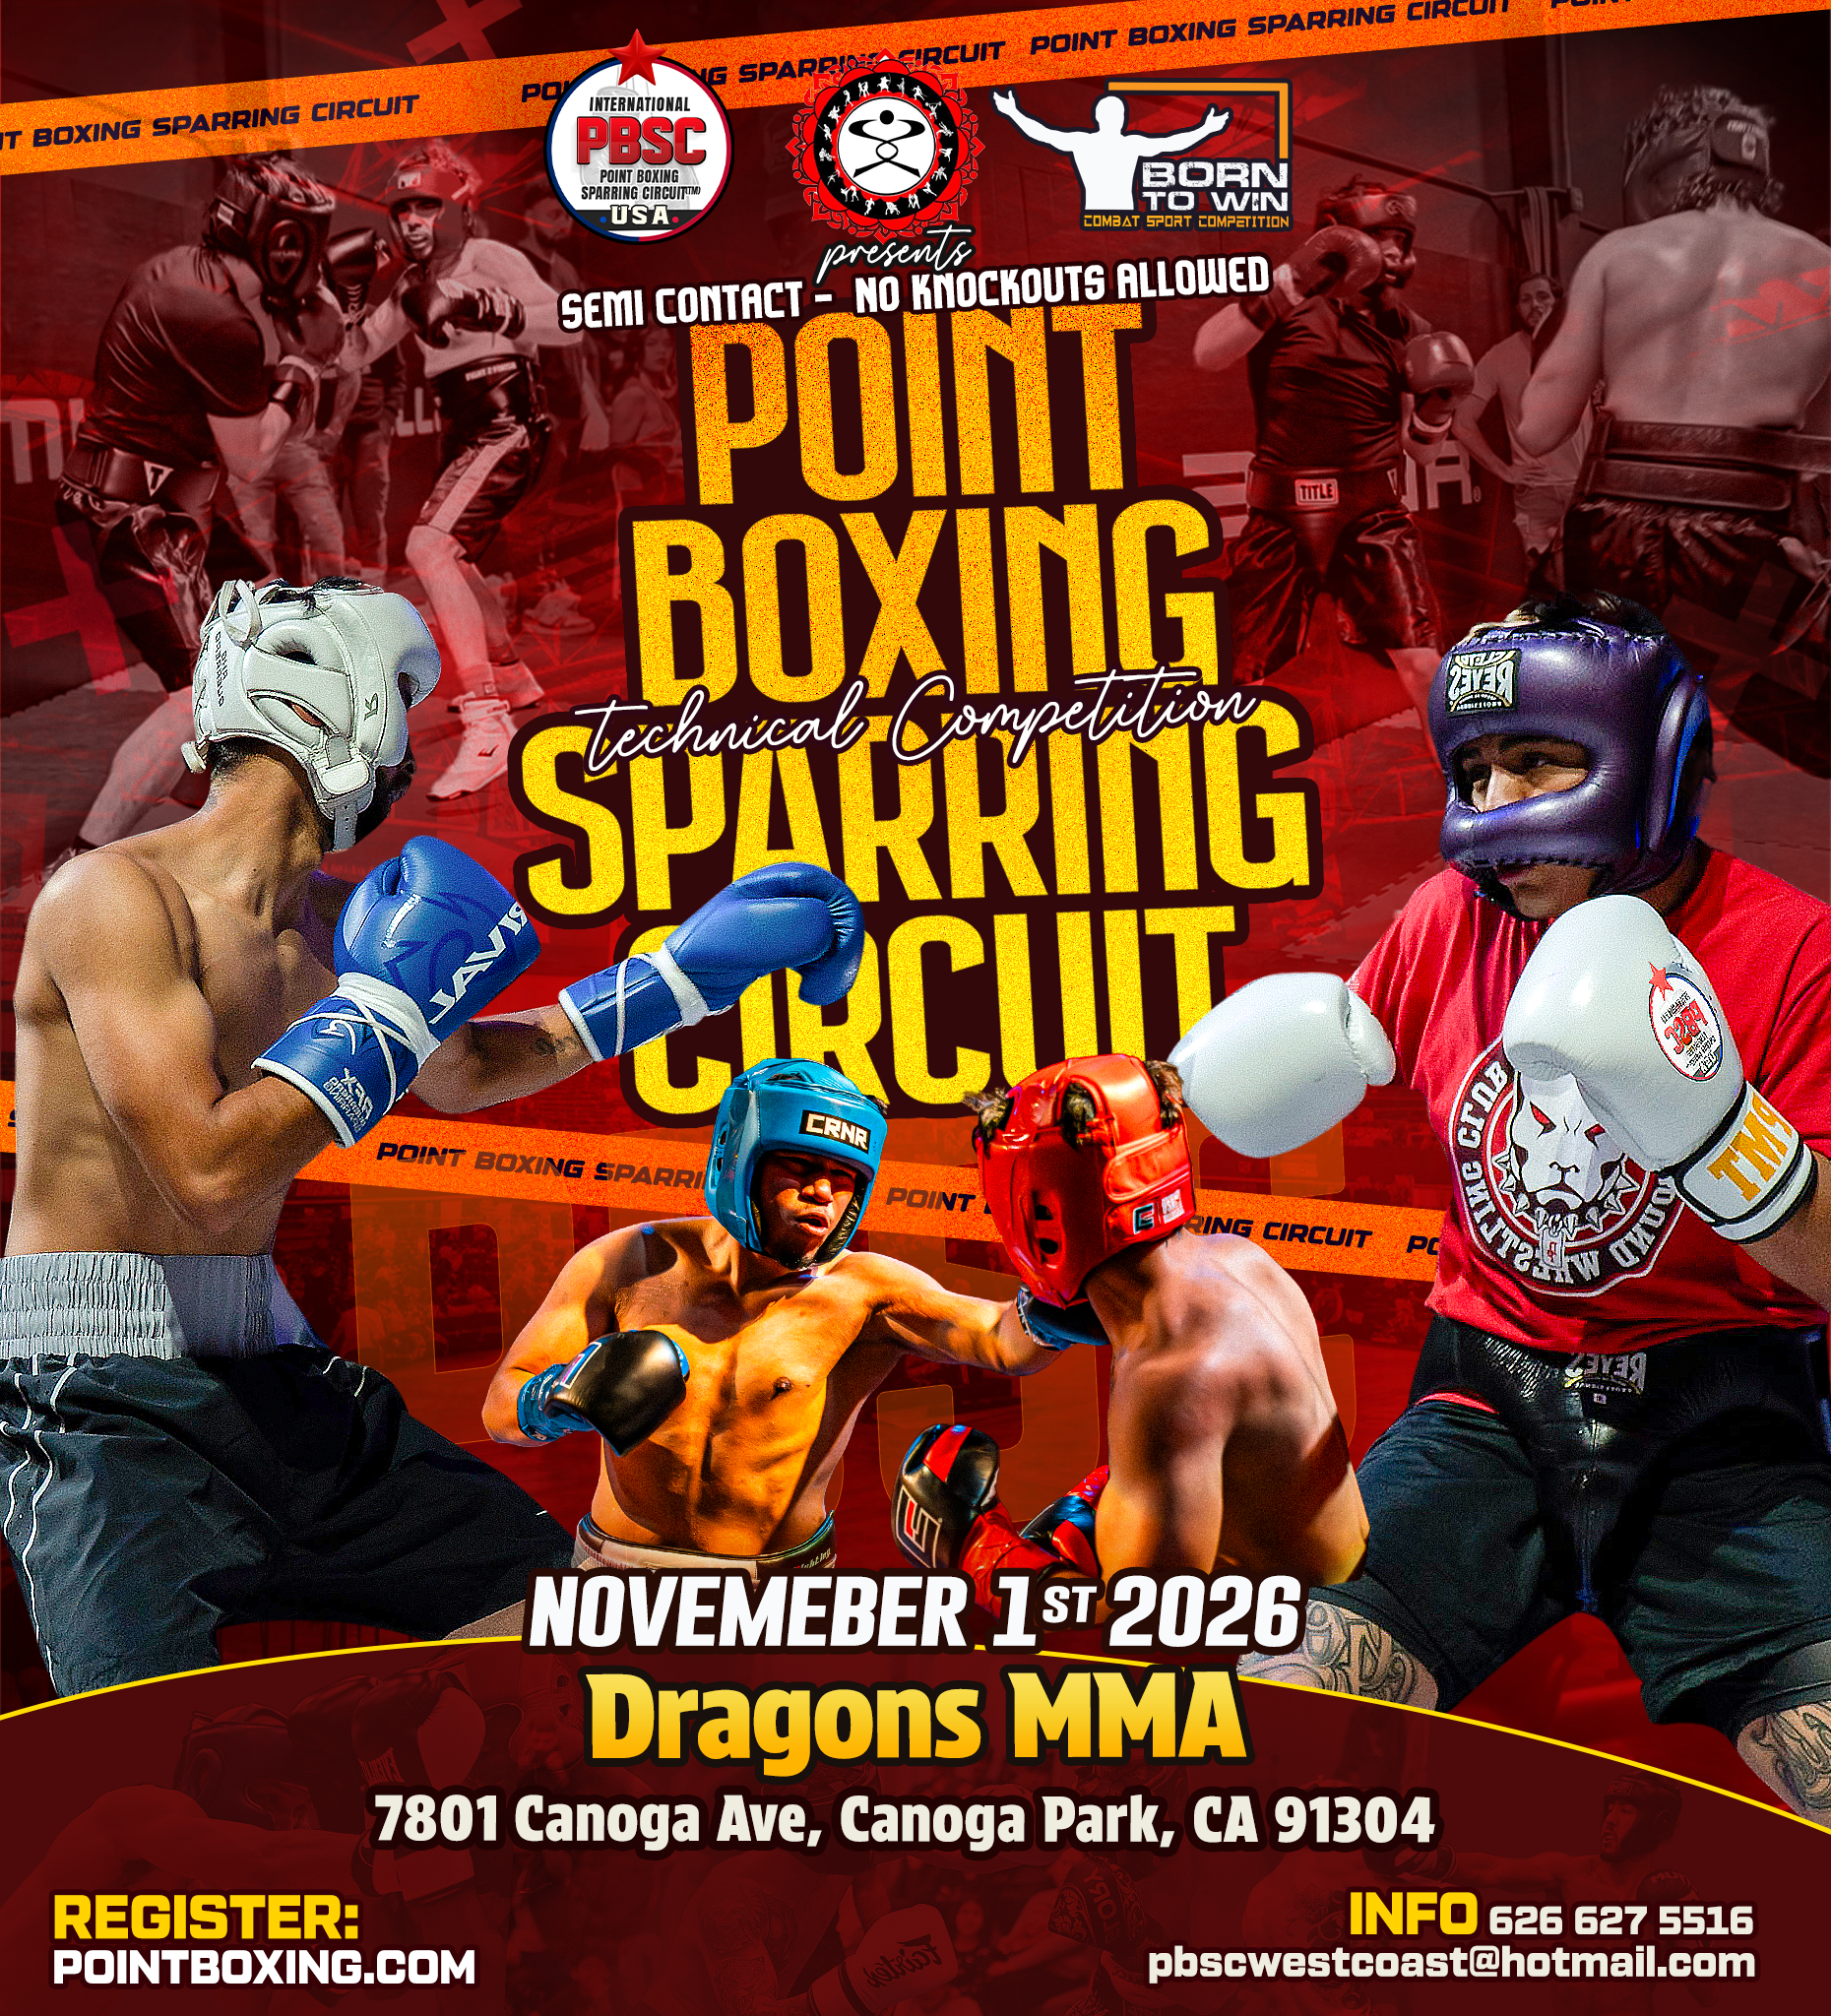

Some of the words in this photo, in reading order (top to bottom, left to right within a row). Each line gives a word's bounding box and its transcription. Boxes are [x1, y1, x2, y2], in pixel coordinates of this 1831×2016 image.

[1030, 29, 1118, 55] POINT
[1128, 19, 1237, 46] BOXING
[1247, 5, 1396, 35] SPARRING
[32, 119, 142, 148] BOXING
[152, 105, 300, 137] SPARRING
[311, 94, 420, 121] CIRCUIT
[589, 96, 691, 113] INTERNATIONAL
[576, 115, 707, 166] PBSC
[581, 186, 638, 201] SPARRING
[599, 169, 633, 184] POINT
[636, 169, 679, 184] BOXING
[1142, 161, 1289, 188] BORN
[609, 204, 671, 226] USA
[1084, 215, 1141, 228] COMBAT
[1146, 215, 1193, 228] SPORT
[1198, 215, 1290, 228] COMPETITION
[1142, 191, 1195, 211] TO
[1210, 191, 1289, 212] WIN
[816, 224, 973, 285] presents
[561, 289, 644, 329] SEMI
[655, 281, 803, 324] CONTACT
[854, 276, 900, 314] NO
[916, 268, 1105, 312] KNOCKOUTS
[1116, 256, 1269, 300] ALLOWED
[689, 302, 1143, 505] POINT
[1299, 482, 1334, 500] TITLE
[632, 499, 1219, 708] BOXING
[575, 685, 866, 774] technical
[891, 666, 1257, 765] Competition
[521, 697, 1311, 916] SPARRING
[807, 1113, 868, 1150] CRNR
[376, 1142, 467, 1167] POINT
[474, 1151, 586, 1179] BOXING
[886, 1187, 977, 1213] POINT
[1262, 1222, 1373, 1248] CIRCUIT
[530, 1575, 968, 1648] NOVEMEBER
[1108, 1575, 1302, 1648] 2026
[586, 1673, 981, 1777] Dragons
[1005, 1670, 1247, 1759] MMA
[375, 1795, 497, 1842] 7801
[515, 1795, 700, 1852] Canoga
[717, 1795, 822, 1847] Ave,
[841, 1795, 1025, 1852] Canoga
[1042, 1794, 1175, 1848] Park,
[1193, 1796, 1259, 1843] CA
[1275, 1796, 1435, 1844] 91304
[54, 1894, 359, 1939] REGISTER:
[1350, 1892, 1478, 1935] INFO
[1488, 1906, 1563, 1935] 626
[1574, 1906, 1648, 1935] 627
[1659, 1906, 1753, 1935] 5516
[53, 1949, 475, 1984] POINTBOXING.COM
[1149, 1945, 1755, 1984] pbscwestcoast@hotmail.com
